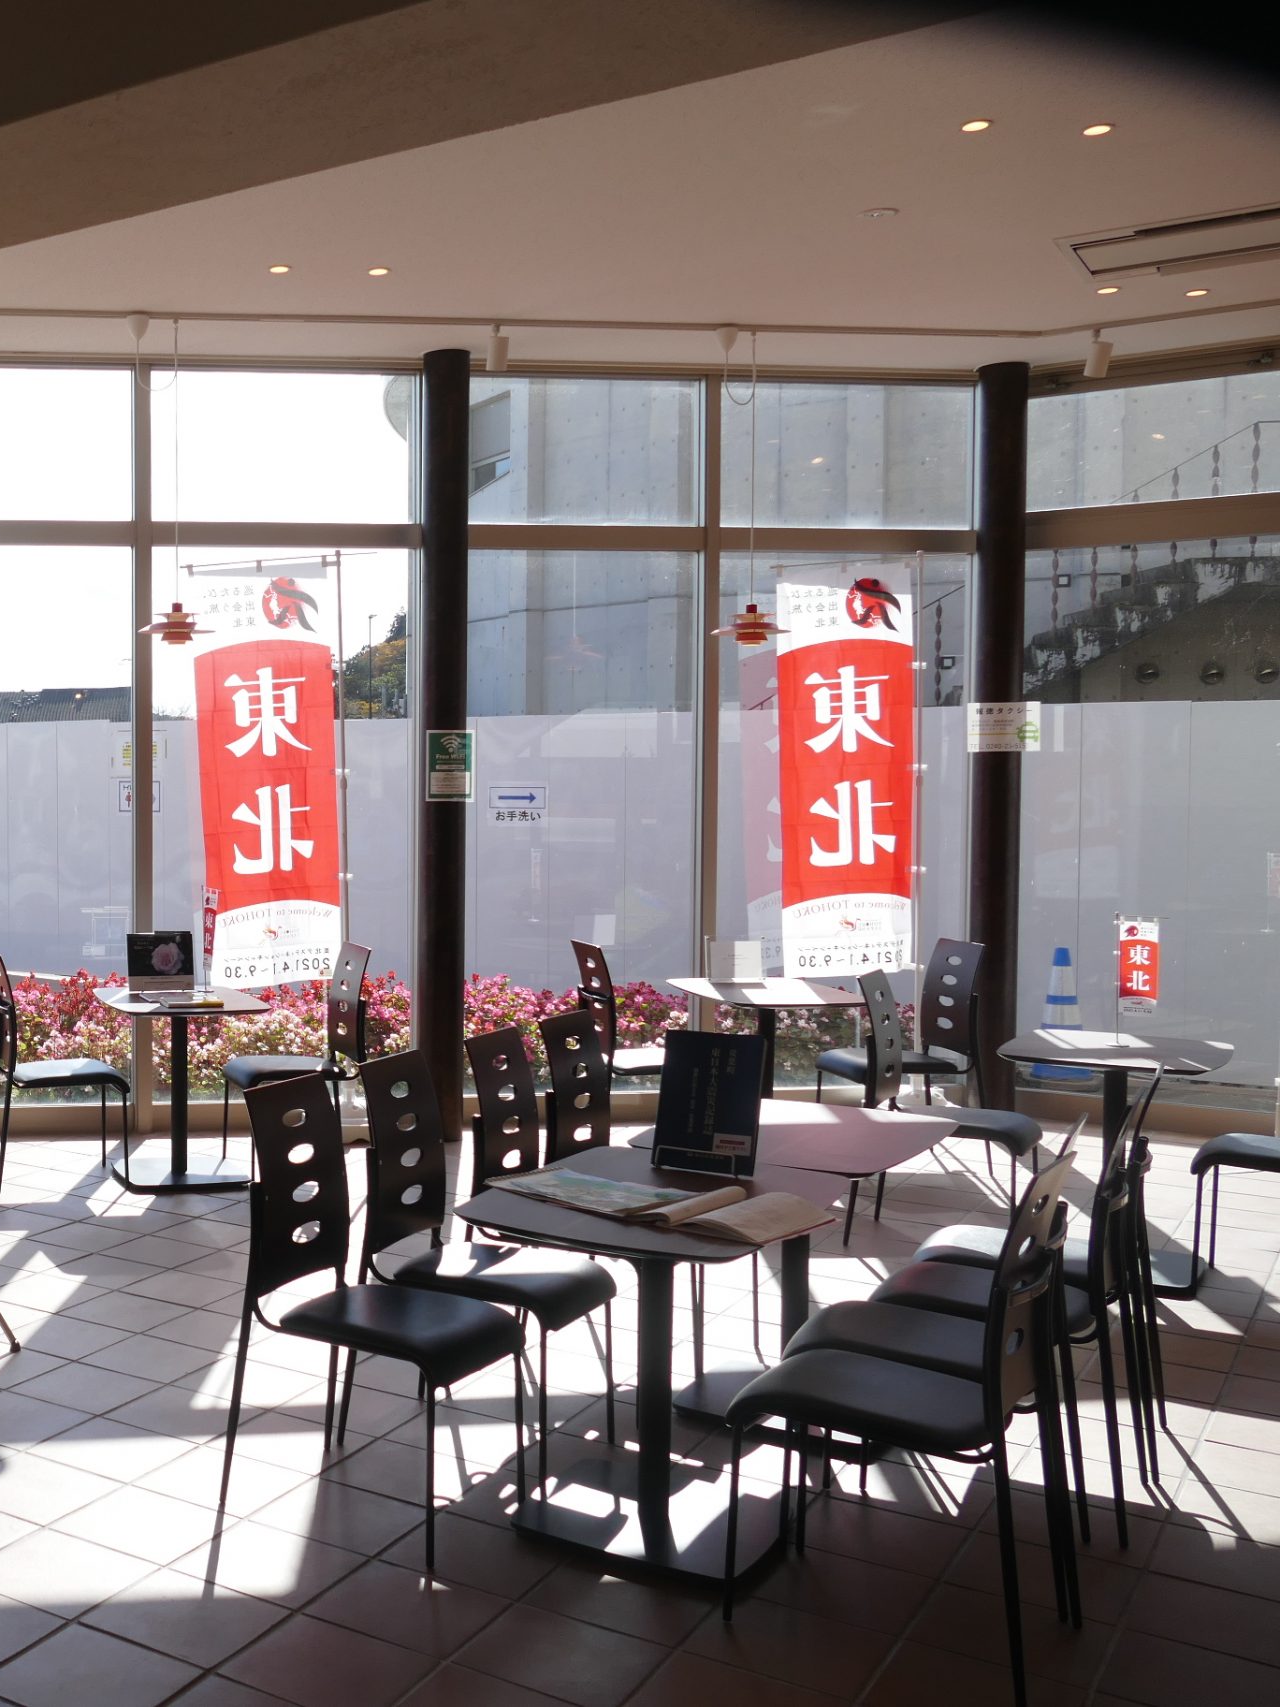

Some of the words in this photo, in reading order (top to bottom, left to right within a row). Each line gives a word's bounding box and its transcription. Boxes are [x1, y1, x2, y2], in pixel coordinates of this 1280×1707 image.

[495, 810, 542, 822] お手洗い
[1126, 944, 1152, 991] 東北
